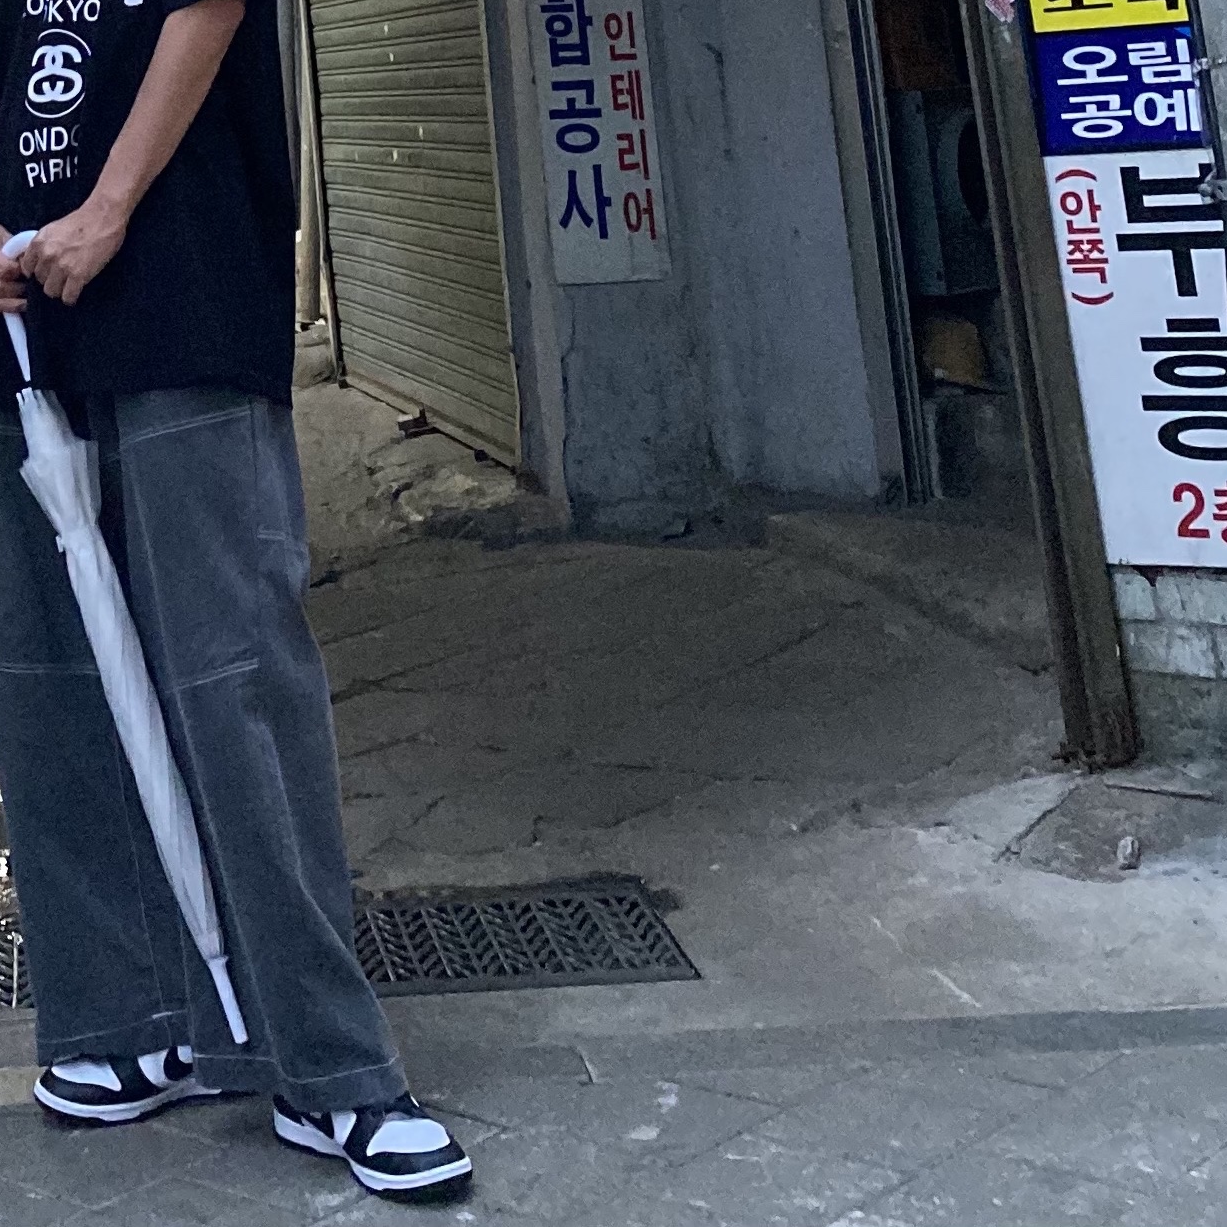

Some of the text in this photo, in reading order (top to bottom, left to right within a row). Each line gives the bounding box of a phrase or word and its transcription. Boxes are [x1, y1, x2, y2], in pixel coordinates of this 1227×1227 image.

[1056, 38, 1196, 87] 오림
[604, 11, 657, 241] 인테리어
[1060, 88, 1202, 139] 공예
